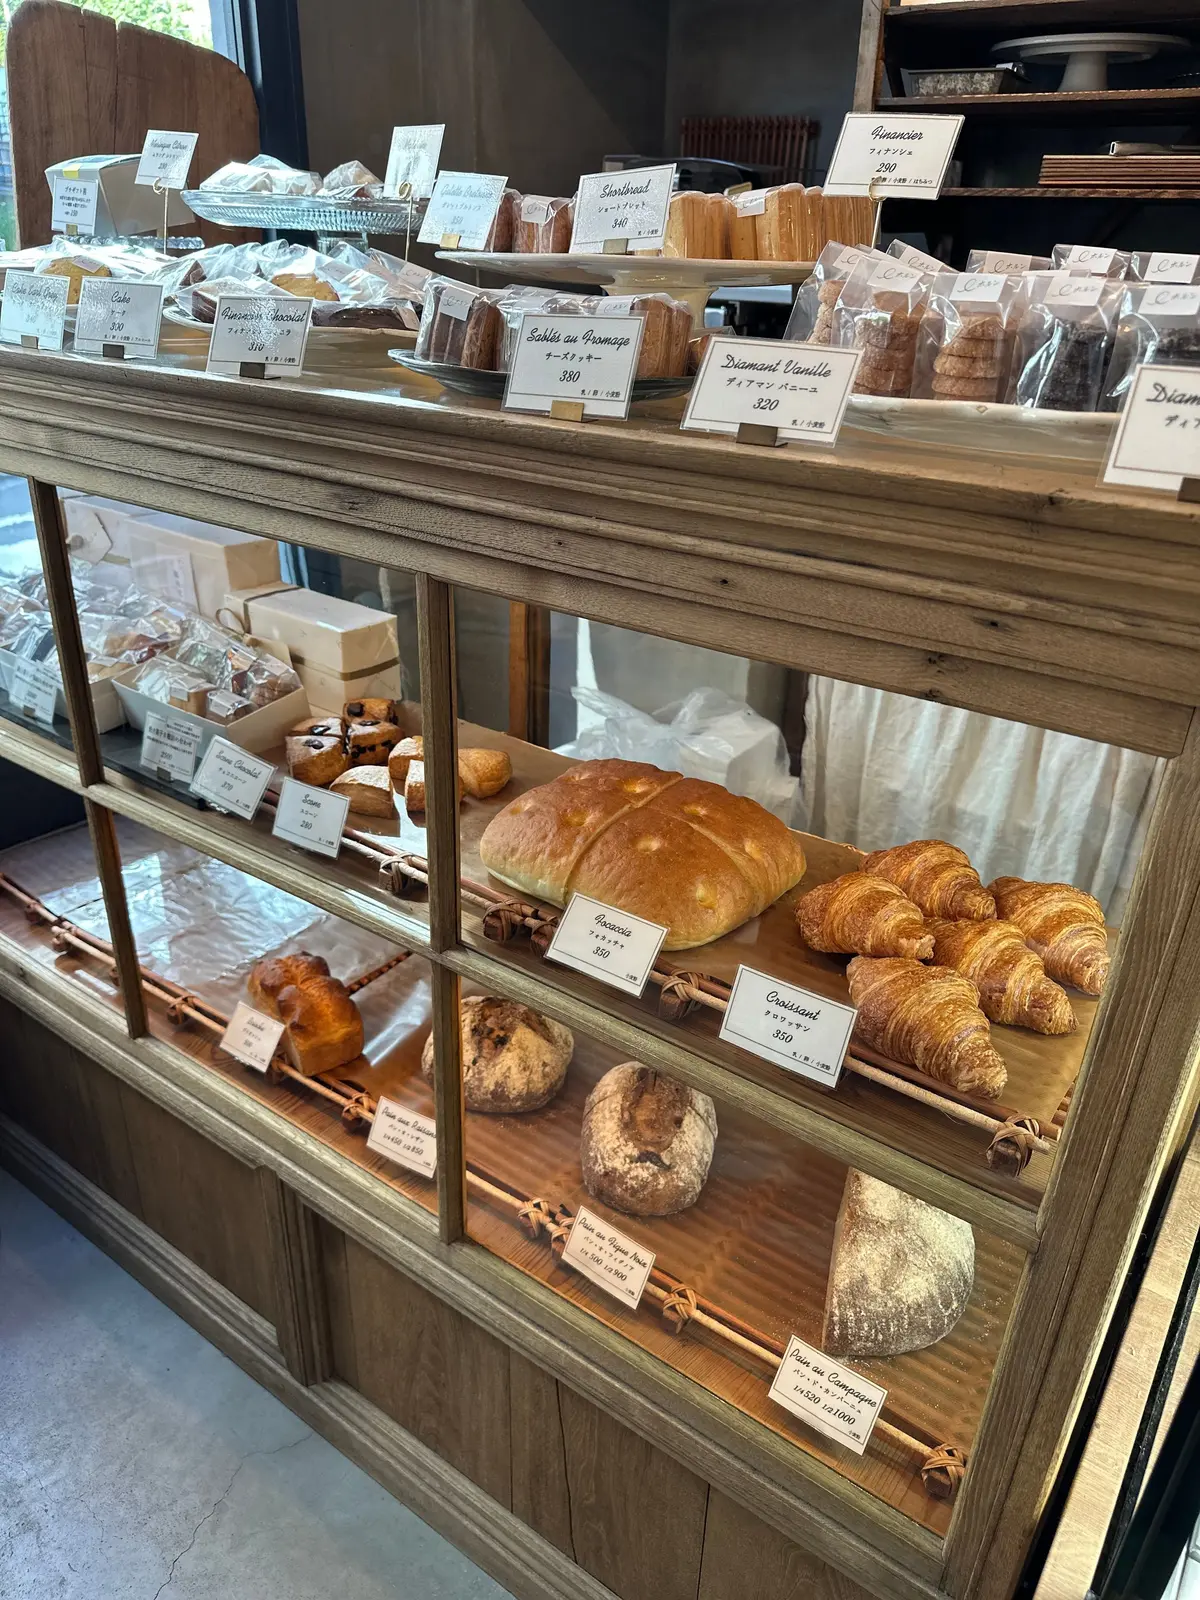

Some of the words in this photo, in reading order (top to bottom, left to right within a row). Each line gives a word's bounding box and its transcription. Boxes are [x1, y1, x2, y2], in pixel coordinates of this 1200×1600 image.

[872, 126, 923, 140] Financier
[870, 148, 913, 156] フィナンシェ
[876, 163, 897, 172] 290
[600, 179, 651, 198] Shortbread
[612, 218, 628, 229] 340
[111, 290, 131, 304] Cake
[268, 308, 306, 322] hocolat
[527, 328, 561, 342] Sablés
[564, 335, 578, 343] au
[582, 330, 630, 351] Fromage
[545, 352, 602, 362] チーズクッキー
[721, 354, 782, 373] Diamant
[784, 360, 832, 378] Vanille
[559, 370, 580, 382] 380
[753, 398, 780, 411] 320
[216, 750, 232, 765] Scone
[234, 760, 262, 779] Chocolat
[302, 794, 322, 808] Scone
[300, 809, 318, 818] スコーン
[595, 914, 632, 938] Focaccia
[588, 930, 624, 949] フォカッチャ
[593, 947, 610, 959] 350
[766, 990, 821, 1021] Croissant
[764, 1010, 810, 1032] クロワッサン
[773, 1029, 793, 1043] 350
[382, 1106, 397, 1120] Pain
[579, 1217, 595, 1234] Pain
[595, 1231, 605, 1240] au
[630, 1252, 647, 1268] Noix
[589, 1254, 603, 1265] 500
[612, 1269, 627, 1281] 900
[789, 1348, 810, 1367] Pain
[812, 1366, 824, 1376] au
[828, 1372, 877, 1407] Campagne
